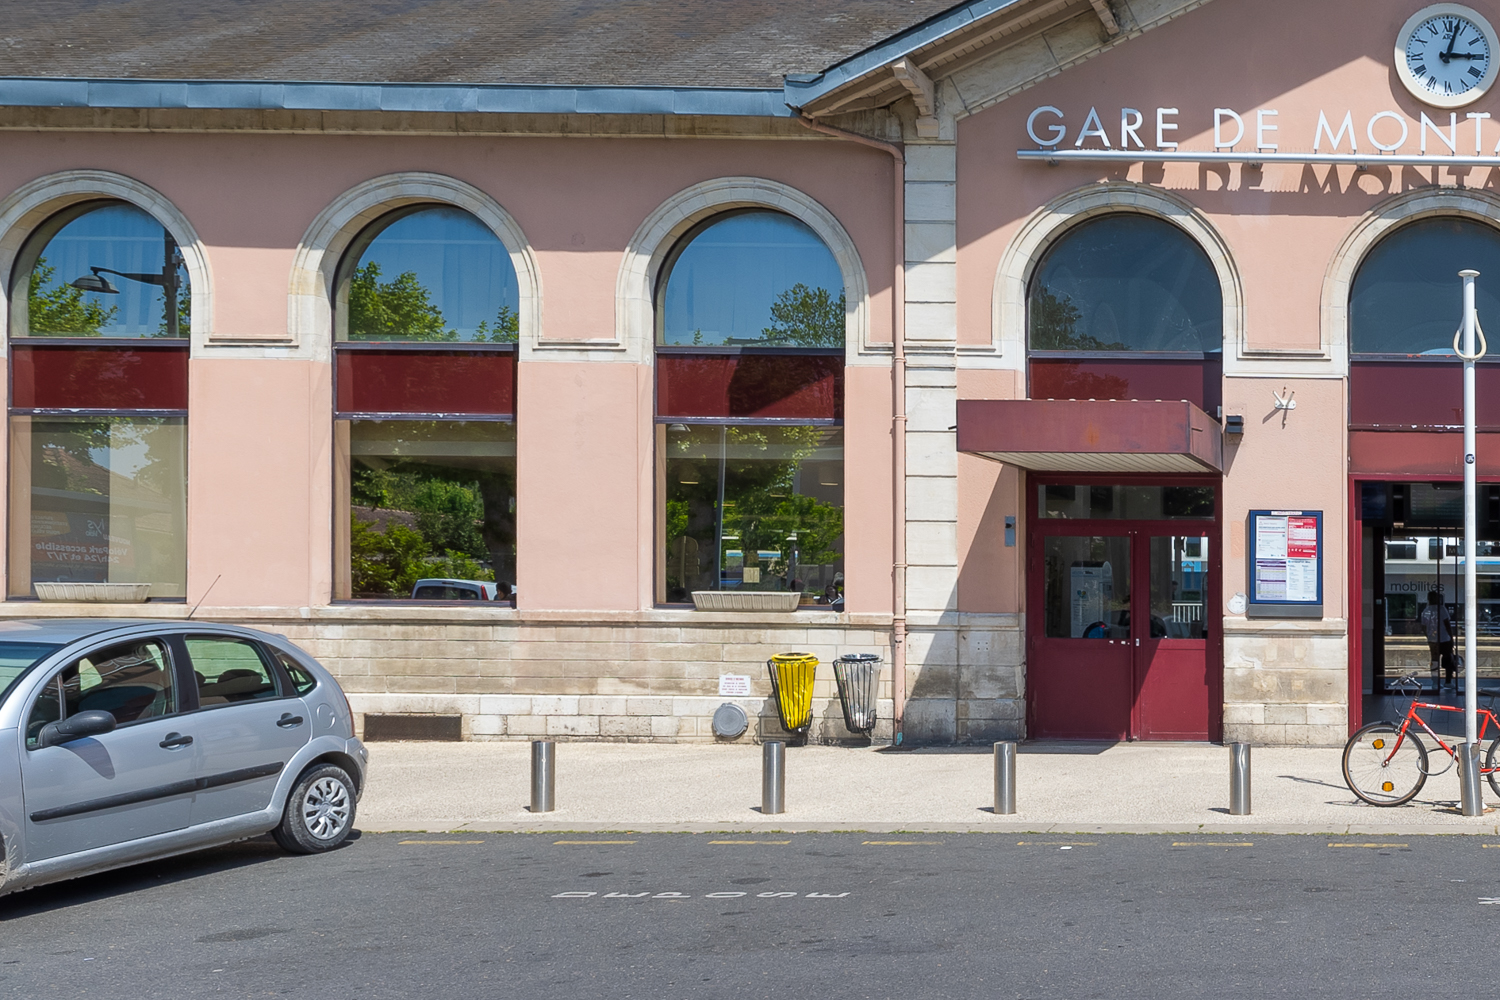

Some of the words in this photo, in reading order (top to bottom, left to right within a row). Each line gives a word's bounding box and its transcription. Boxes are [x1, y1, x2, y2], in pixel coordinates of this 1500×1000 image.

[1026, 105, 1179, 148] GARE
[1213, 107, 1279, 149] DE
[1390, 580, 1445, 592] mobilités
